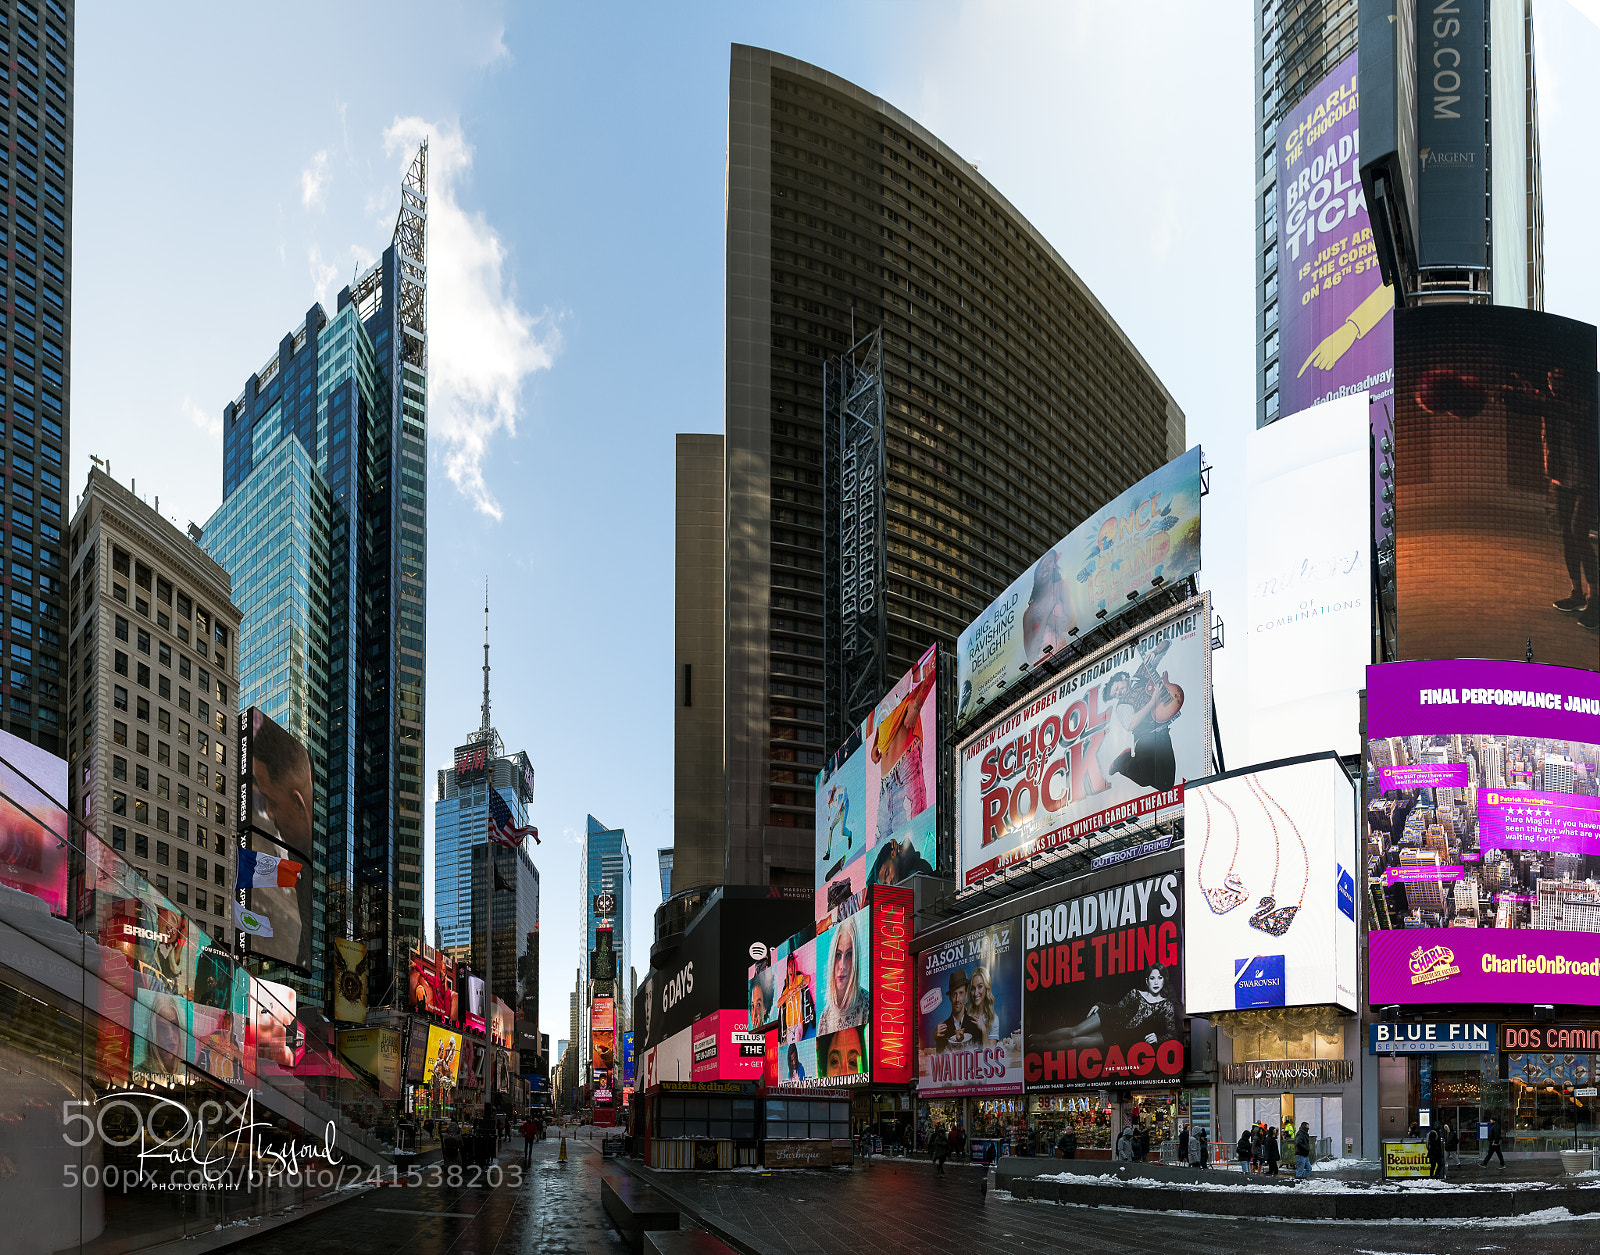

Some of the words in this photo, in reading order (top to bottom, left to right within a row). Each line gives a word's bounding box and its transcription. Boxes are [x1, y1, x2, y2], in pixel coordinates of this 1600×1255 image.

[1285, 140, 1303, 171] THE
[1299, 263, 1311, 281] IS
[1314, 237, 1348, 267] JUST
[1311, 260, 1335, 284] THE
[1301, 284, 1319, 306] ON
[1323, 265, 1351, 290] 46TH
[843, 443, 857, 522] EAGLE
[860, 464, 875, 614] OUTFITTERS
[1098, 492, 1161, 550] ONCE
[1088, 531, 1170, 605] ISLAND
[843, 527, 857, 655] AMERICAN
[1300, 599, 1314, 609] OF
[975, 620, 991, 641] BIG,
[994, 593, 1019, 623] BOLD
[1257, 598, 1361, 632] COMBINATIONS
[969, 610, 1015, 660] RAVISHING
[997, 716, 1021, 743] LLOYD
[1024, 691, 1057, 722] WEBBER
[1059, 680, 1077, 699] HAS
[1080, 650, 1136, 687] BROADWAY
[1420, 688, 1459, 705] FINAL
[1461, 688, 1562, 711] PERFORMANCE
[980, 686, 1112, 793] SCHOOL
[1026, 746, 1051, 785] of
[981, 729, 1112, 849] ROCK
[998, 854, 1013, 868] JUST
[1014, 851, 1019, 861] 4
[1020, 839, 1046, 858] BLOCKS
[1047, 833, 1056, 846] TO
[1057, 827, 1071, 842] THE
[1073, 814, 1103, 835] WINTER
[1105, 803, 1138, 828] GARDEN
[1140, 788, 1179, 812] THEATRE
[1505, 833, 1535, 843] waiting
[1525, 817, 1552, 826] Magic!
[1527, 825, 1542, 833] this
[1543, 827, 1557, 835] yet
[1559, 828, 1578, 836] what
[1142, 837, 1171, 852] PRIME
[1026, 874, 1178, 950] BROADWAY'S
[123, 924, 170, 943] BRIGHT
[881, 904, 905, 966] EAGLE
[926, 945, 964, 969] JASON
[969, 930, 1010, 955] MRAZ
[1025, 944, 1085, 991] SURE
[1091, 920, 1178, 977] THING
[1411, 947, 1451, 973] CHARLIE
[1481, 953, 1600, 976] CharlieOnBroad
[662, 984, 668, 1013] 6
[669, 960, 694, 1009] DAYS
[1238, 978, 1280, 989] SWAROVSKI
[881, 967, 905, 1068] AMERICAN
[1377, 1023, 1437, 1041] BLUE
[1449, 1023, 1488, 1040] FIN
[744, 1045, 763, 1054] THE
[1451, 1042, 1488, 1050] SUSHI
[1506, 1029, 1541, 1049] DOS
[930, 1045, 1005, 1083] WAITRESS
[1024, 1040, 1184, 1082] CHICAGO
[1265, 1068, 1318, 1079] SWAROVSKI
[662, 1082, 697, 1091] wafels
[707, 1083, 740, 1092] dinges
[1114, 1078, 1182, 1086] CHICAGOTHEMUSICAL.COM
[985, 1100, 1024, 1112] GRAND
[1050, 1097, 1090, 1111] SLAM
[1387, 1153, 1431, 1165] Beautifu
